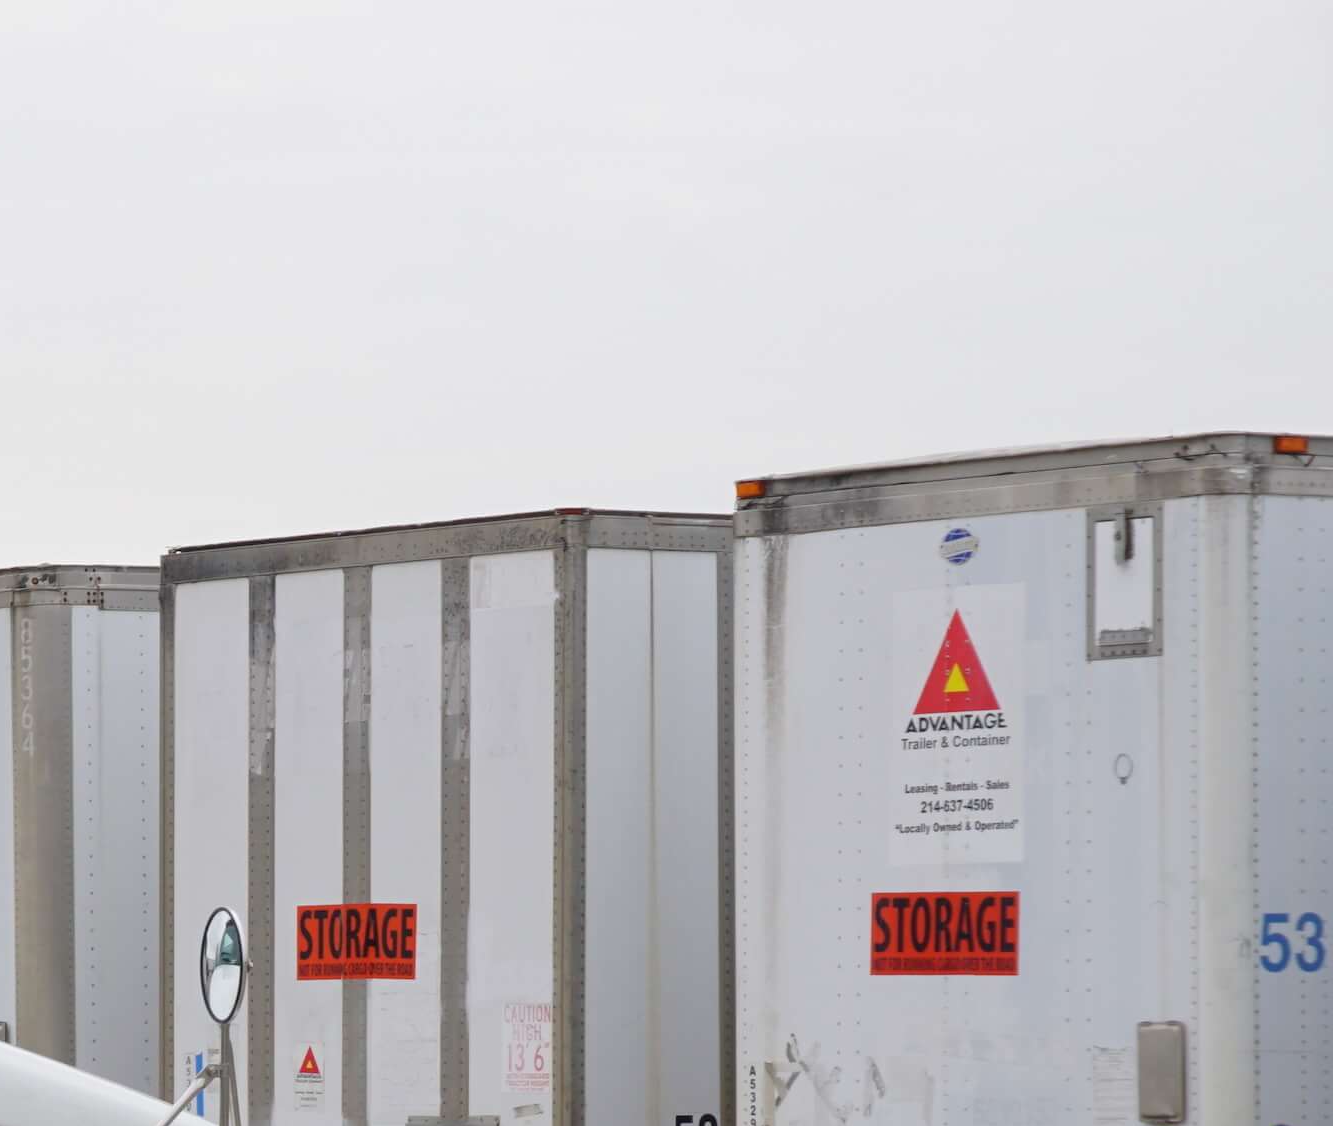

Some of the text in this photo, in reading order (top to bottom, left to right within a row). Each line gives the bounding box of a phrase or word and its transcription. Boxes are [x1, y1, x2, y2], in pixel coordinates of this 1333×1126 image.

[901, 734, 1010, 750] Trailer & Container
[906, 712, 1008, 733] ADVANTAGE
[299, 907, 414, 960] STORAGE
[874, 896, 1015, 953] STORAGE
[1260, 911, 1326, 973] 53
